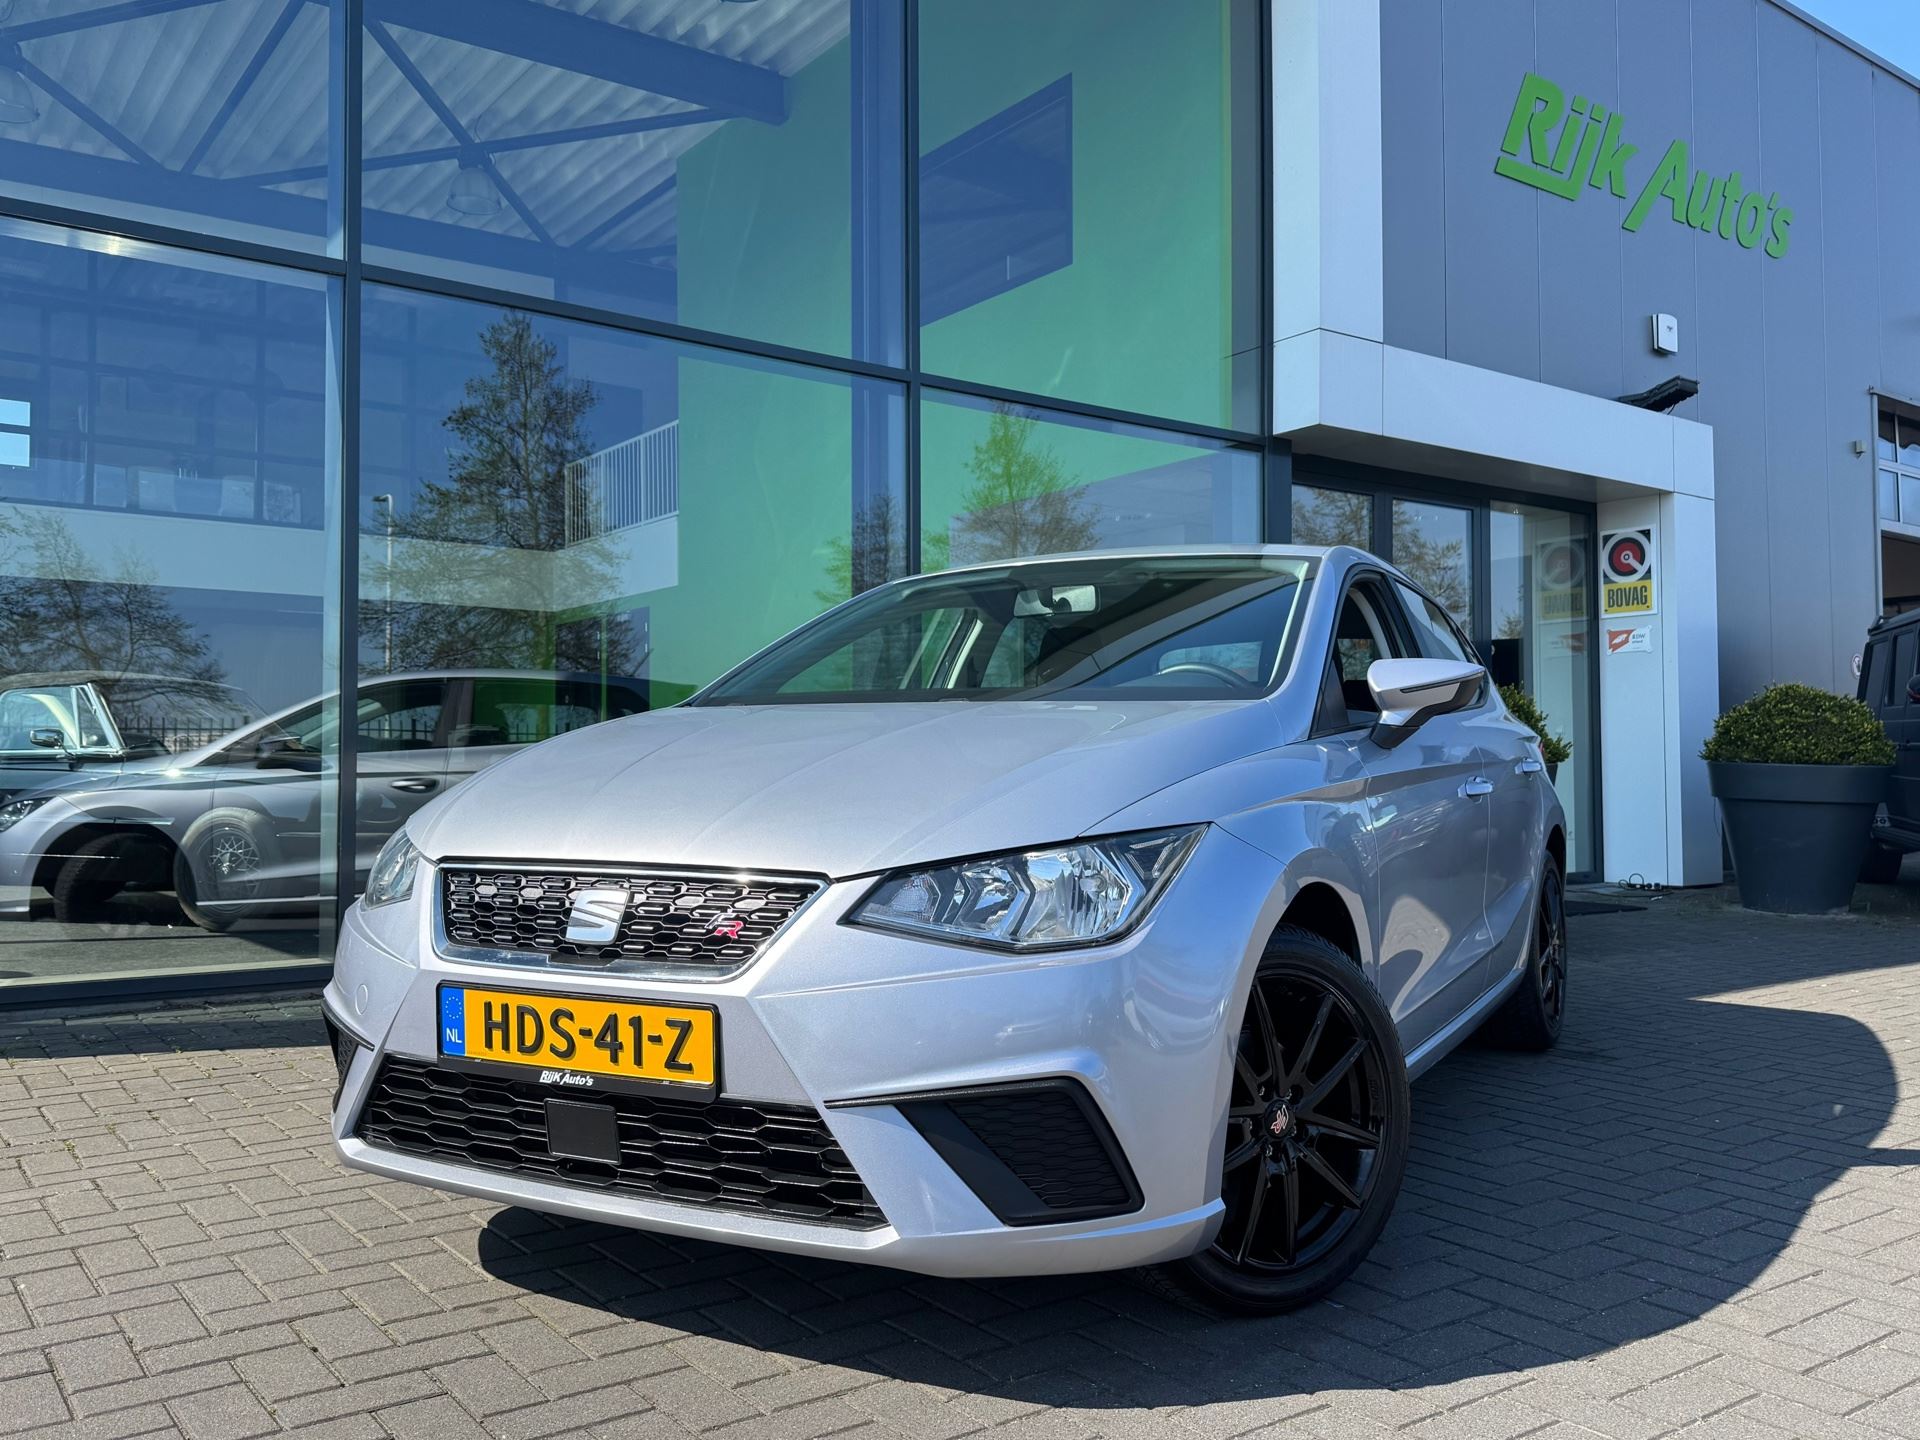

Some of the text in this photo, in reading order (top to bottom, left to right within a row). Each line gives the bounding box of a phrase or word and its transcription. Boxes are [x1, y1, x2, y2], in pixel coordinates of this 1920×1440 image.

[1495, 72, 1795, 259] Rijk Auto's
[1607, 585, 1648, 609] BOVAG
[704, 912, 744, 939] FR
[446, 1028, 463, 1044] NL
[484, 1001, 694, 1073] HDS-41-Z
[560, 1073, 594, 1086] Auto's
